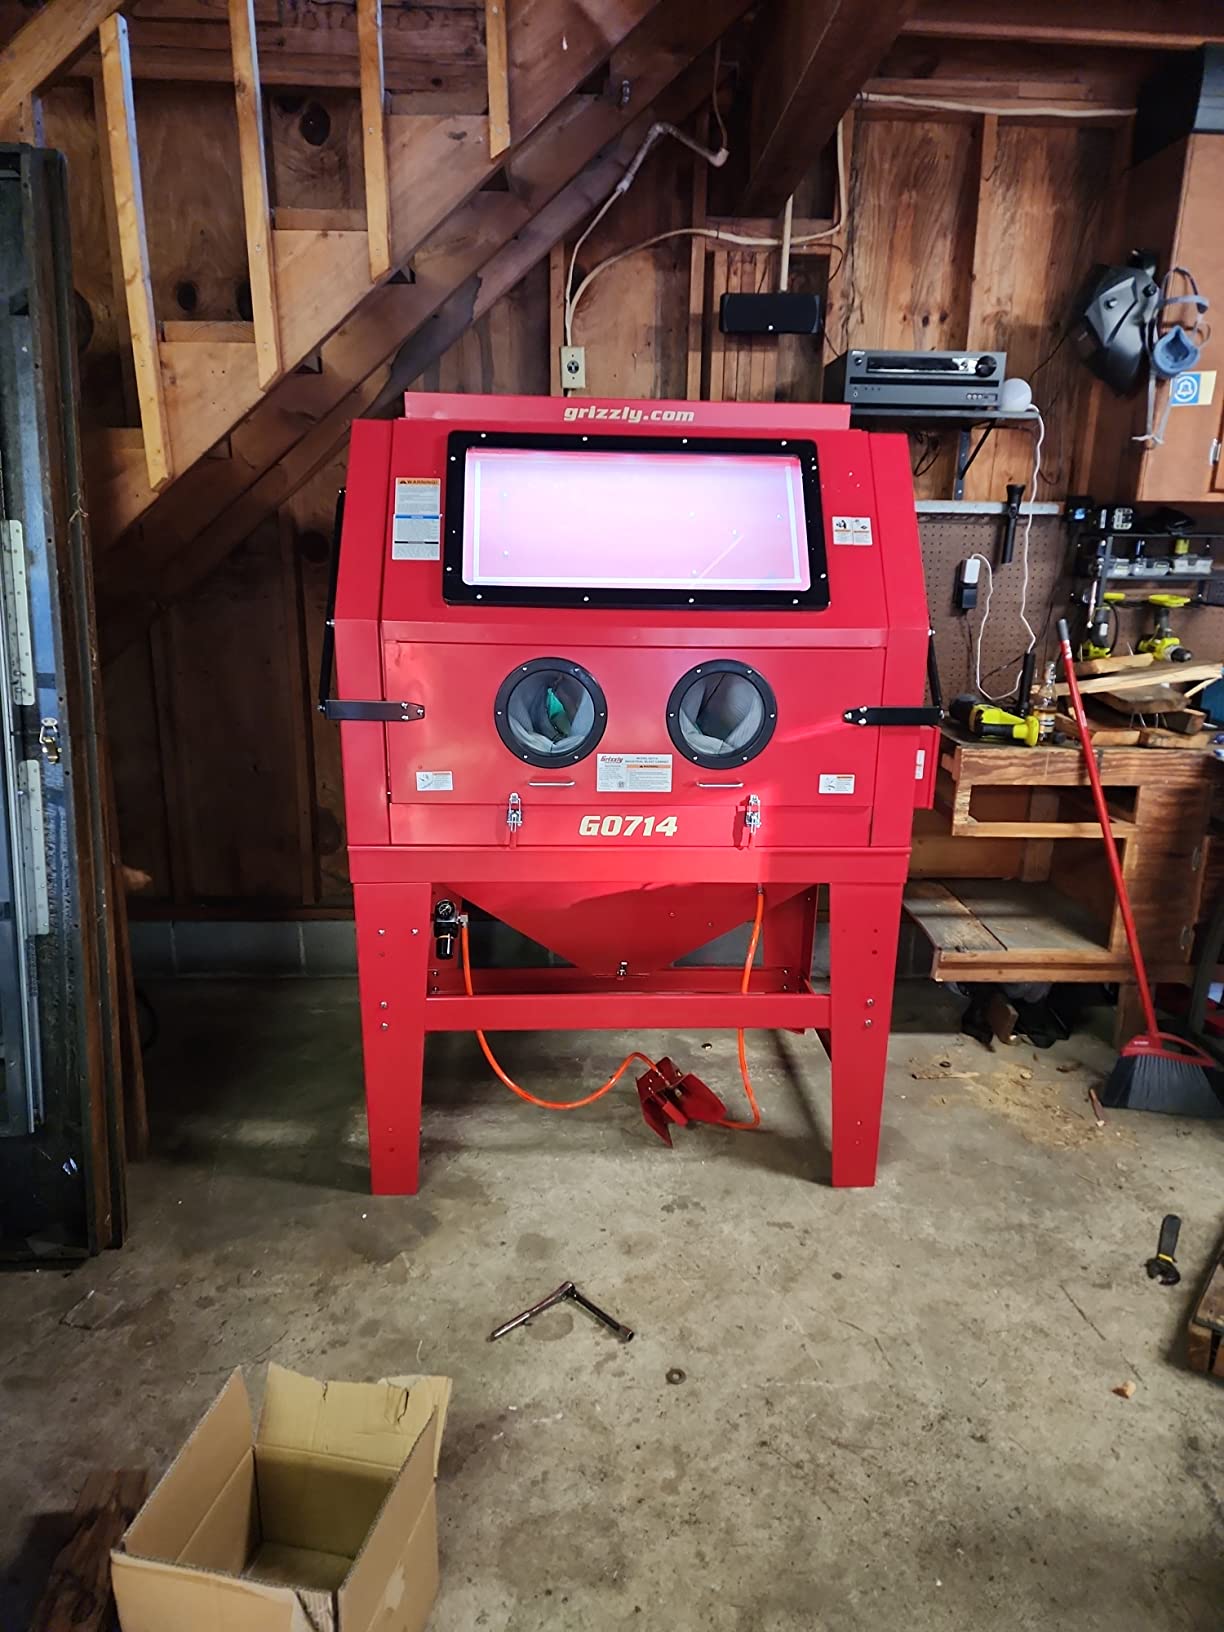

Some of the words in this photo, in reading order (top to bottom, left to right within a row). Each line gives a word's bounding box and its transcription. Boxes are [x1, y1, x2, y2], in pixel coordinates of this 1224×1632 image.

[563, 405, 695, 423] grizzly.com
[600, 755, 624, 764] Grizzly
[579, 815, 678, 837] G0714
